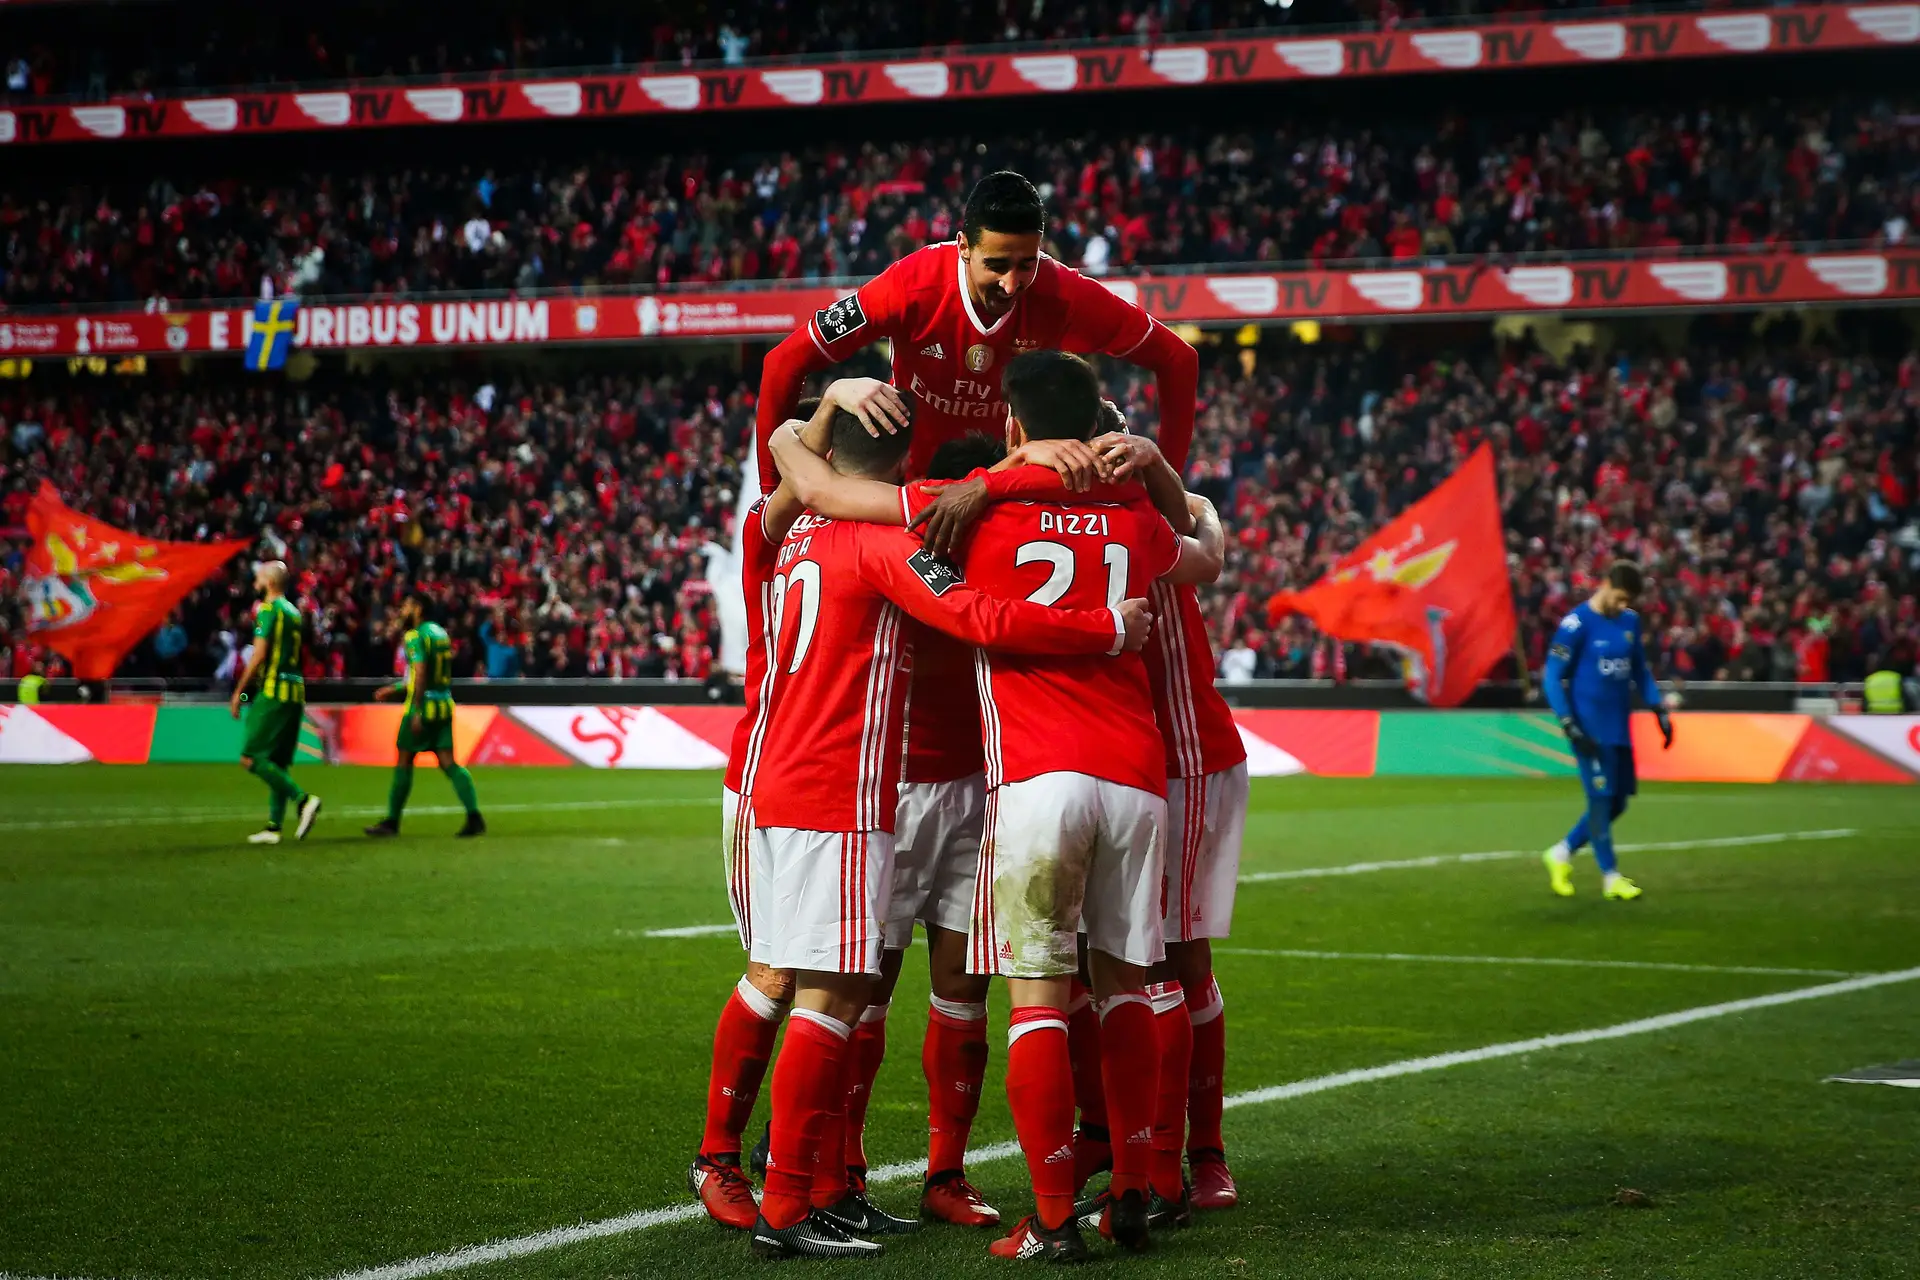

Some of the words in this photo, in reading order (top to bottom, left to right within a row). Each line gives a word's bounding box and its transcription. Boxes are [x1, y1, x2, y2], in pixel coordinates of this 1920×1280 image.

[210, 311, 229, 350] E
[432, 301, 549, 341] UNUM
[910, 372, 1009, 419] Emirat
[953, 379, 992, 399] Fly
[1014, 540, 1129, 609] 21
[1016, 1242, 1044, 1260] adidas
